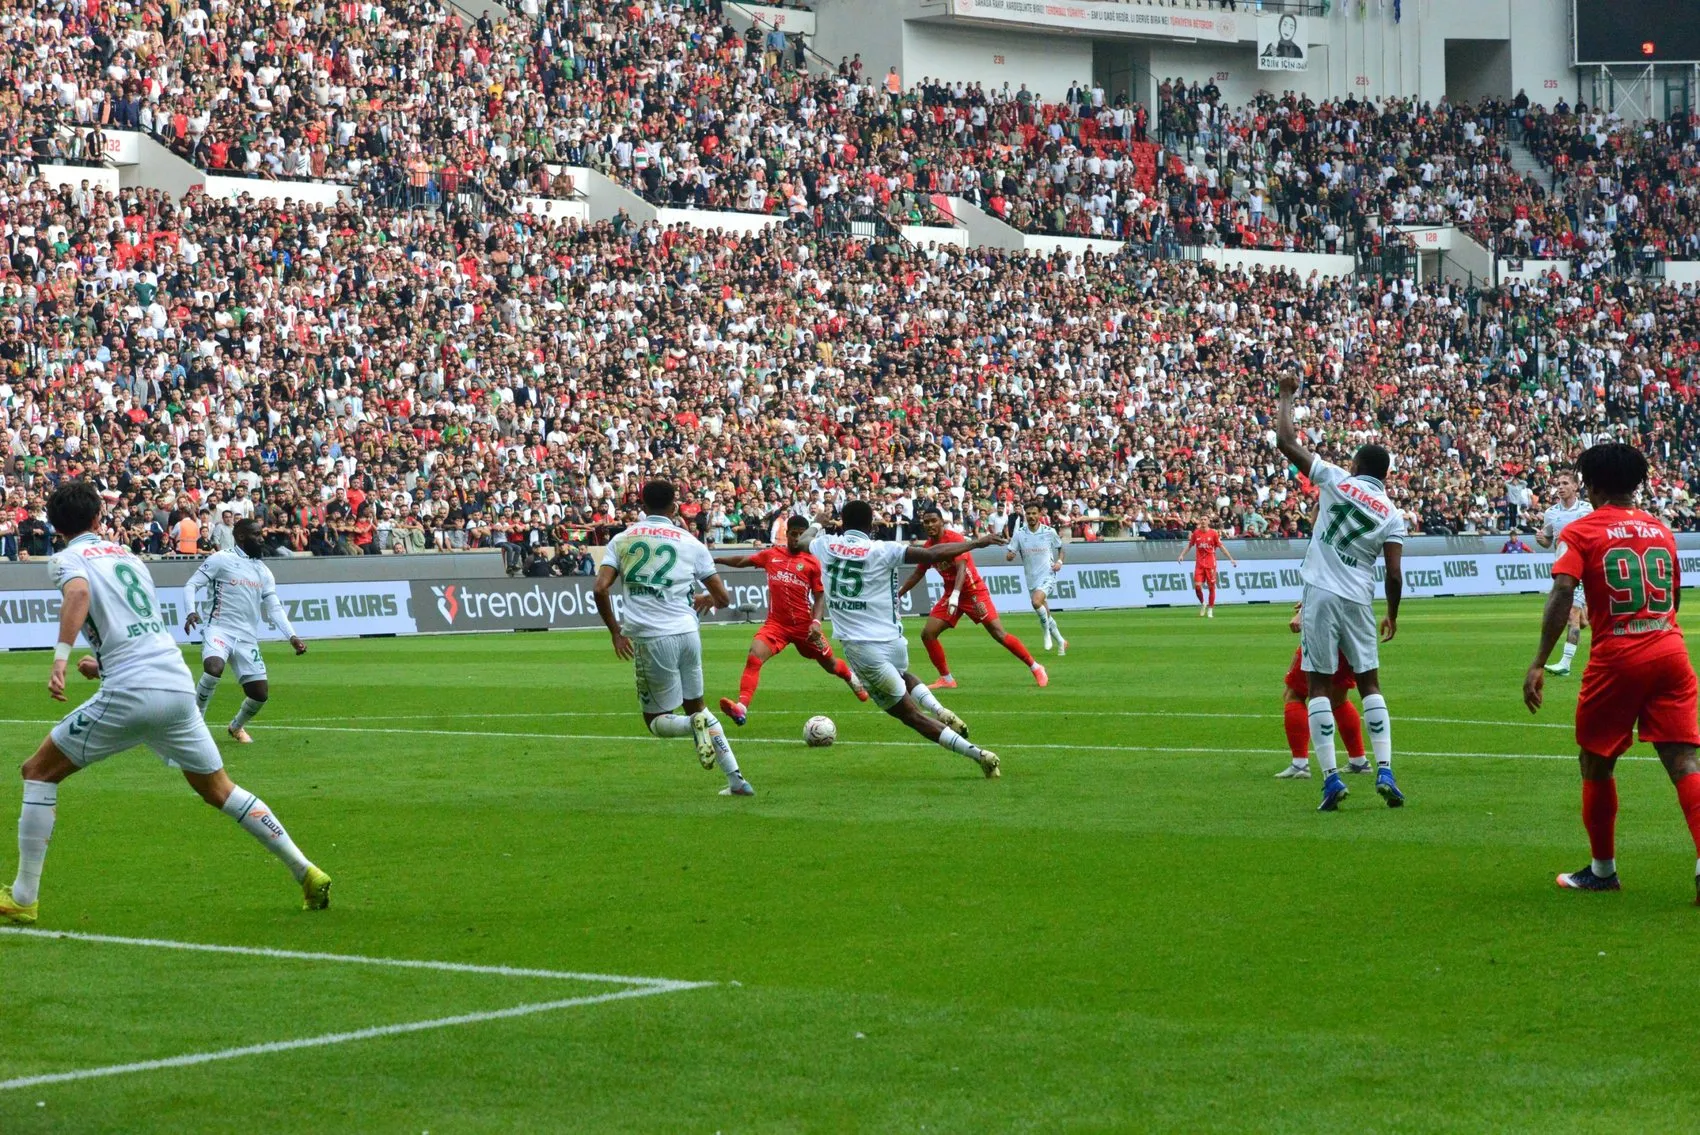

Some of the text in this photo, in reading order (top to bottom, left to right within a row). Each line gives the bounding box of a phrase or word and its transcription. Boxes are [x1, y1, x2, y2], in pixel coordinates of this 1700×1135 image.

[1216, 72, 1229, 81] 237
[1543, 80, 1558, 89] 235
[1425, 233, 1438, 243] 128
[625, 541, 677, 587] 22
[1443, 560, 1479, 578] KURS
[114, 562, 153, 618] 8
[826, 558, 864, 598] 15
[1077, 569, 1121, 589] KURS
[1602, 546, 1674, 616] 99
[335, 593, 398, 619] KURS
[461, 583, 584, 624] trendyol
